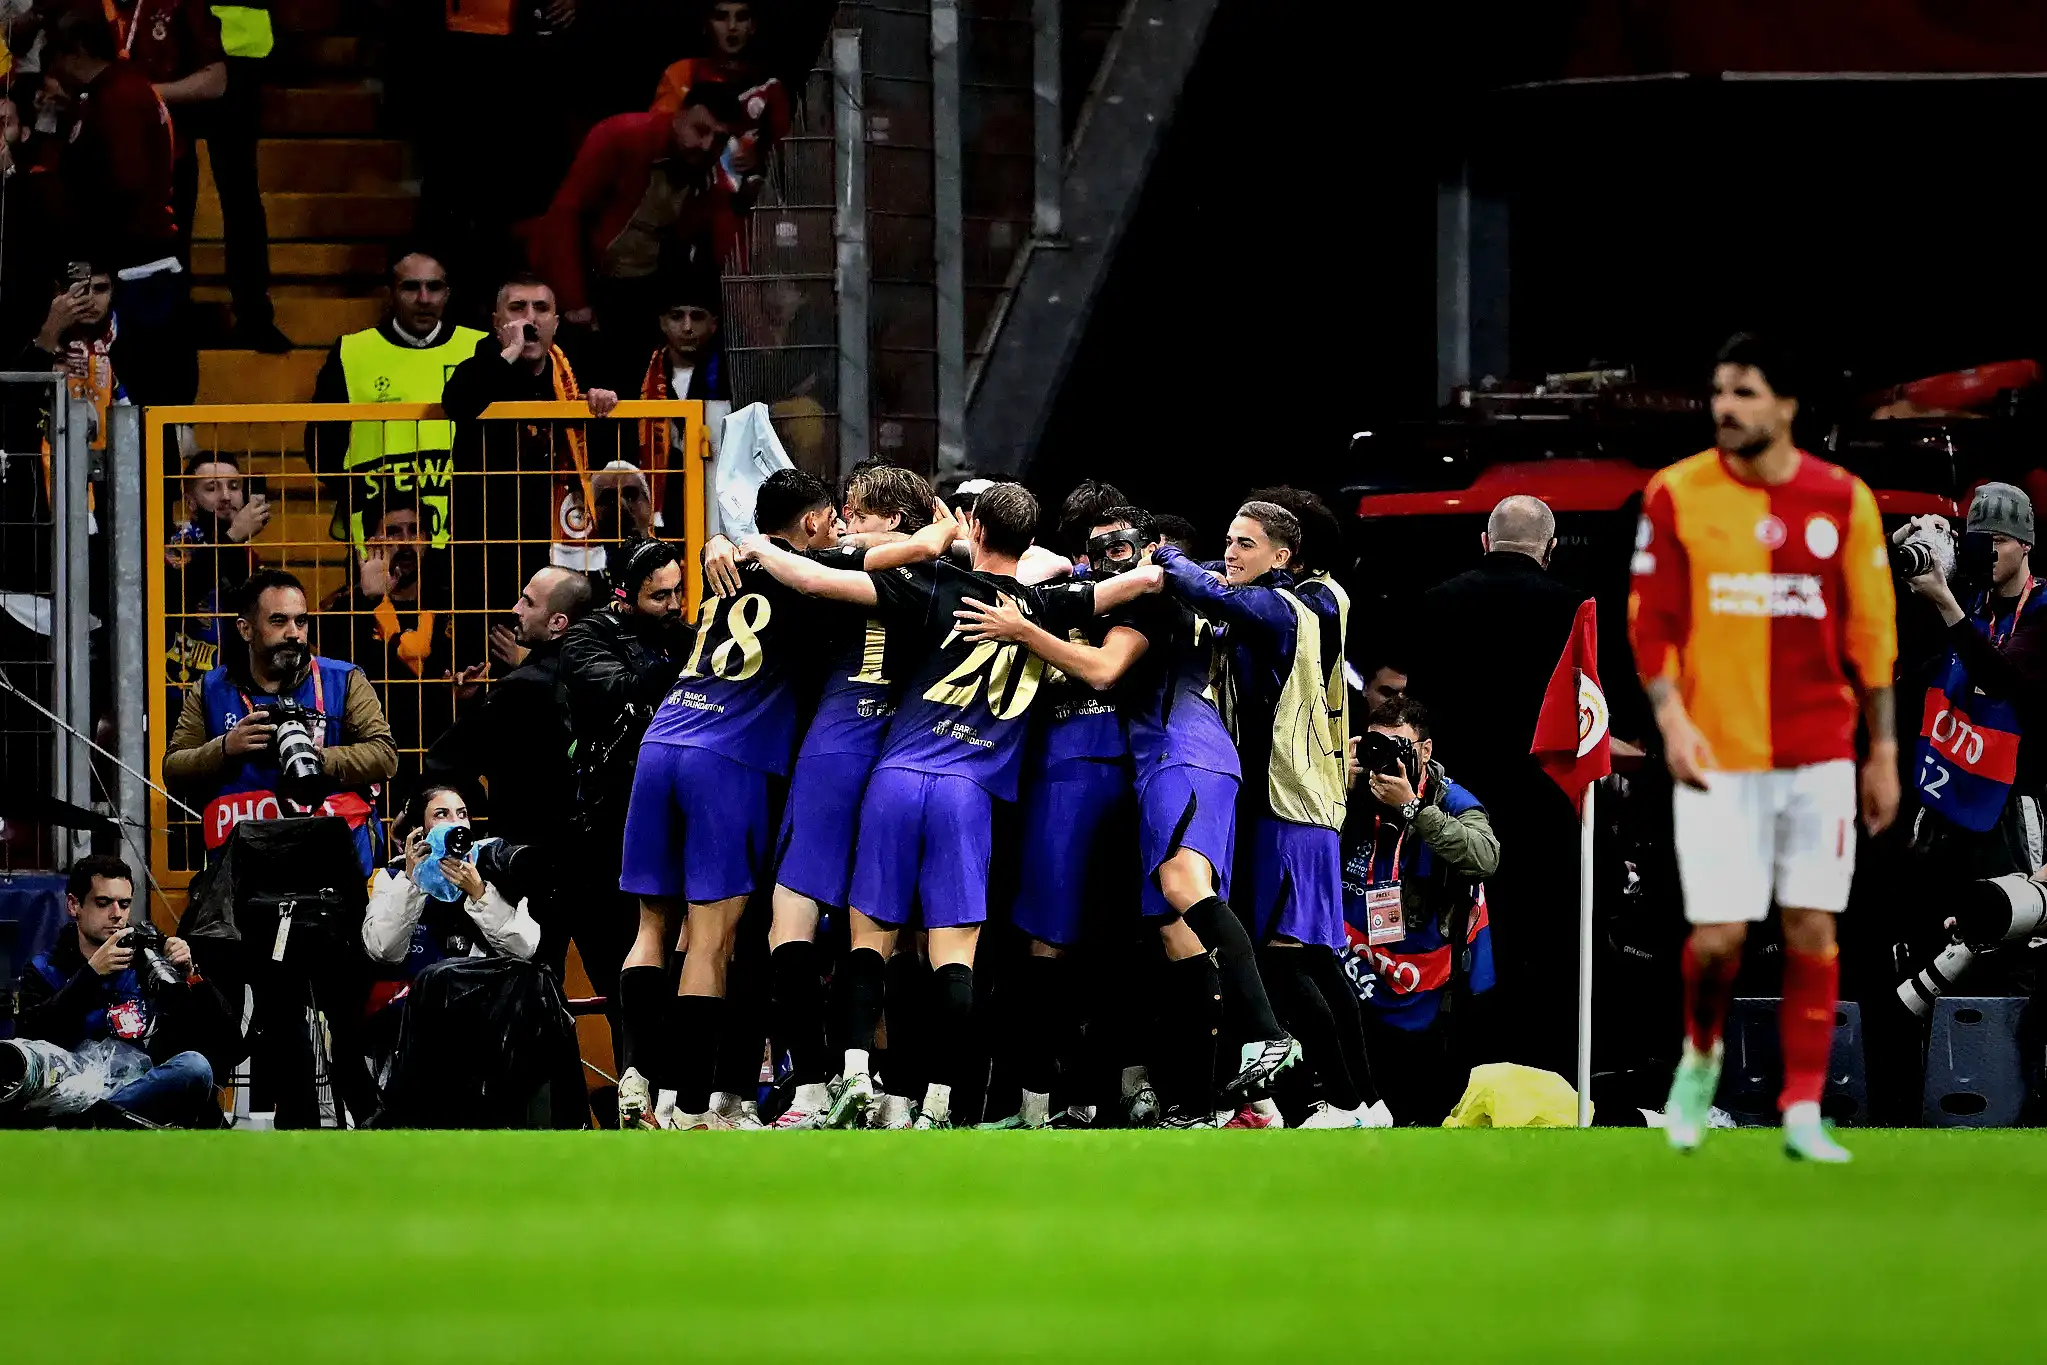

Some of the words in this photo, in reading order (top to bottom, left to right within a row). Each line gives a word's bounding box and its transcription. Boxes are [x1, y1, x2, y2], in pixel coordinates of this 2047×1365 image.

[679, 593, 772, 682] 18
[922, 620, 1044, 720] 20
[682, 699, 725, 714] FOUNDATION
